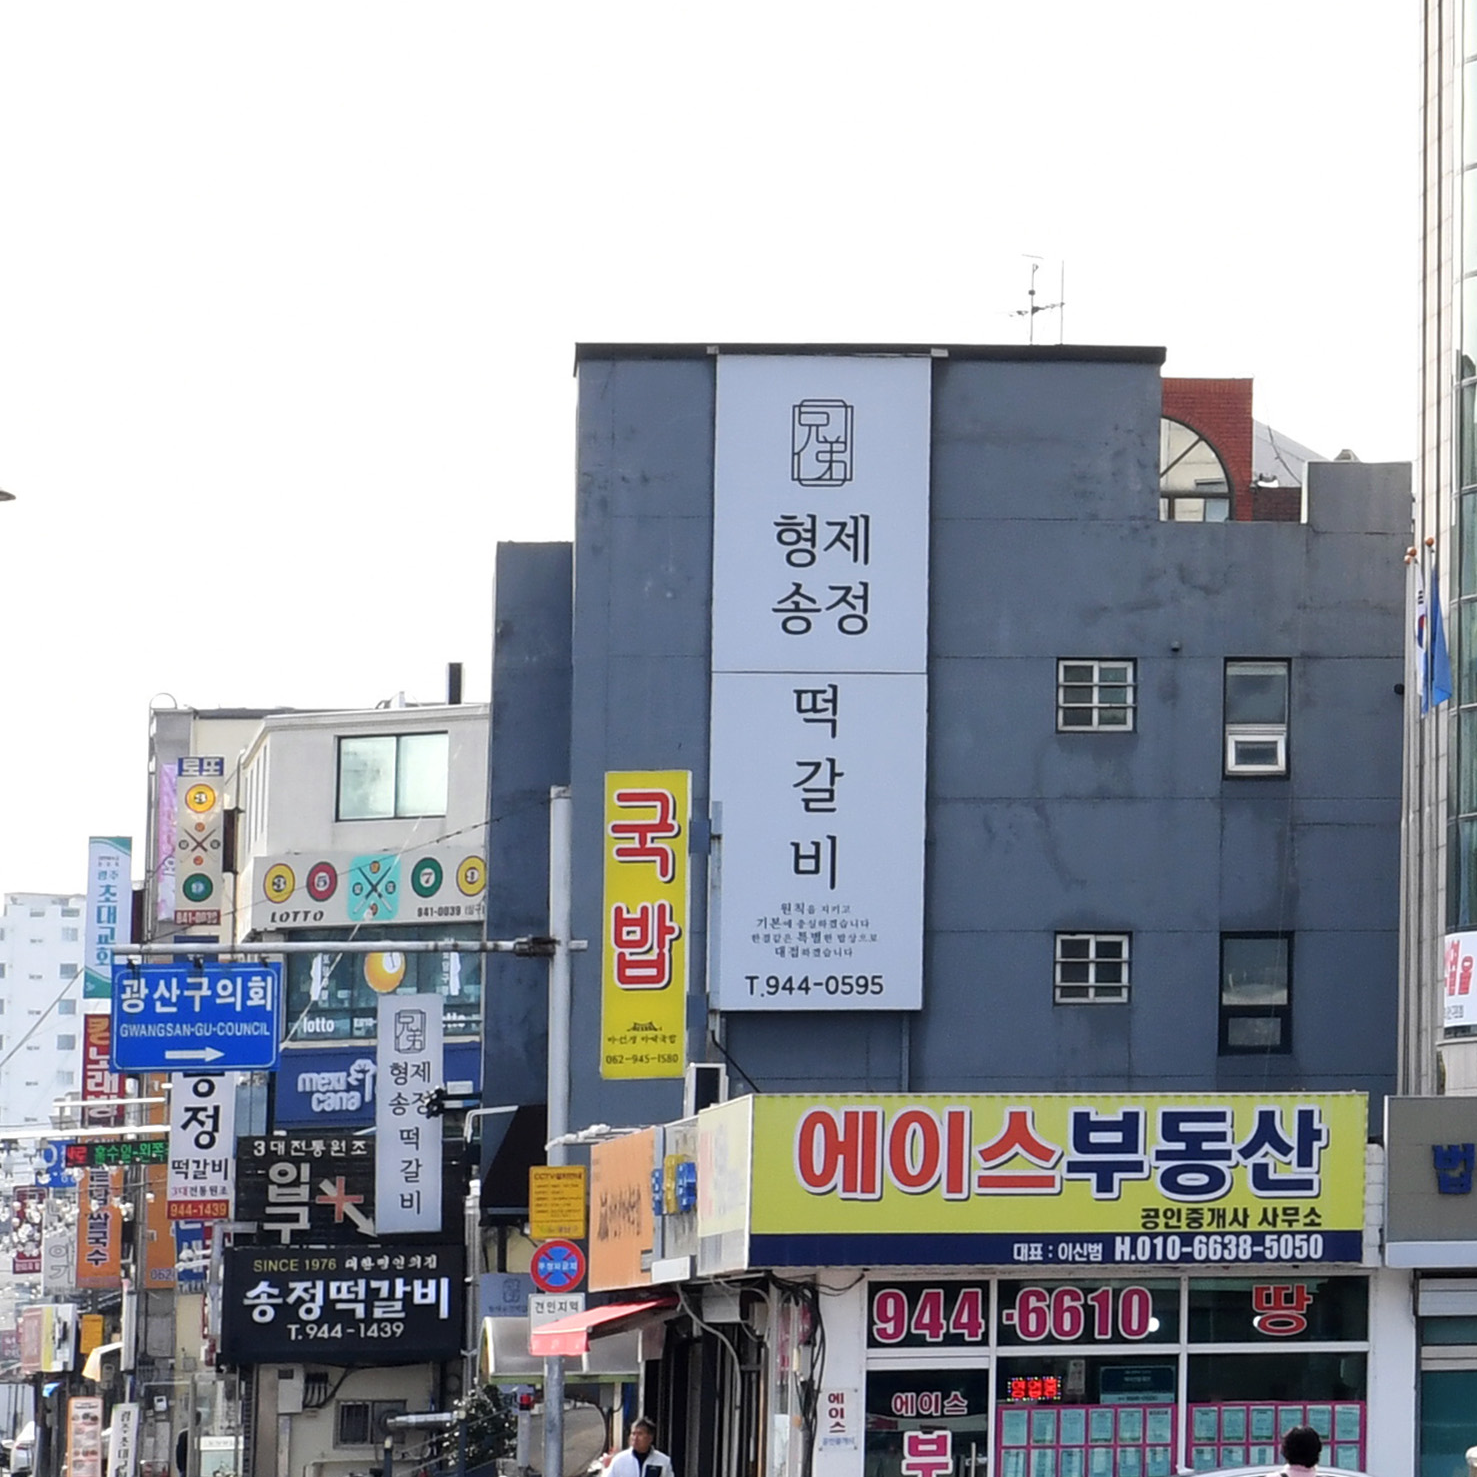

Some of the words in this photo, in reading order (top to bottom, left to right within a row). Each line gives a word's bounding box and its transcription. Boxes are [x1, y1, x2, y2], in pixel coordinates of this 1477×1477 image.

[773, 512, 872, 568] 형제
[771, 580, 872, 636] 송정
[182, 758, 222, 776] 로또
[789, 683, 845, 891] 떡갈비
[607, 787, 682, 991] 국밥
[96, 884, 118, 966] 초대교회
[270, 910, 324, 923] LOTTO
[757, 917, 792, 930] 기본에
[797, 931, 832, 944] 특별한
[120, 975, 273, 1014] 광산구의회
[744, 975, 884, 997] T.944-0595
[303, 1016, 335, 1033] lotto
[605, 1054, 679, 1064] 062-945-1580
[297, 1072, 348, 1093] mexi
[389, 1060, 432, 1086] 형제
[311, 1091, 362, 1112] cana
[793, 1103, 1330, 1204] 에이스부동산
[171, 1157, 228, 1181] 떡갈비
[399, 1125, 423, 1215] 떡갈비
[170, 1202, 227, 1217] 944-1439
[262, 1161, 311, 1245] 입구
[1139, 1206, 1250, 1229] 공인중개사
[1257, 1205, 1323, 1229] 사무소
[1013, 1243, 1044, 1262] 대표
[1058, 1242, 1103, 1262] 이신범
[1114, 1234, 1324, 1261] H.010-6638-5050
[253, 1259, 299, 1272] SINCE
[304, 1258, 337, 1271] 1976
[243, 1276, 450, 1324] 송정떡갈비
[535, 1300, 580, 1314] 견인지역
[1251, 1284, 1314, 1337] 땅
[286, 1322, 405, 1342] T.944-1439
[828, 1392, 846, 1433] 에이스
[891, 1391, 968, 1416] 에이스
